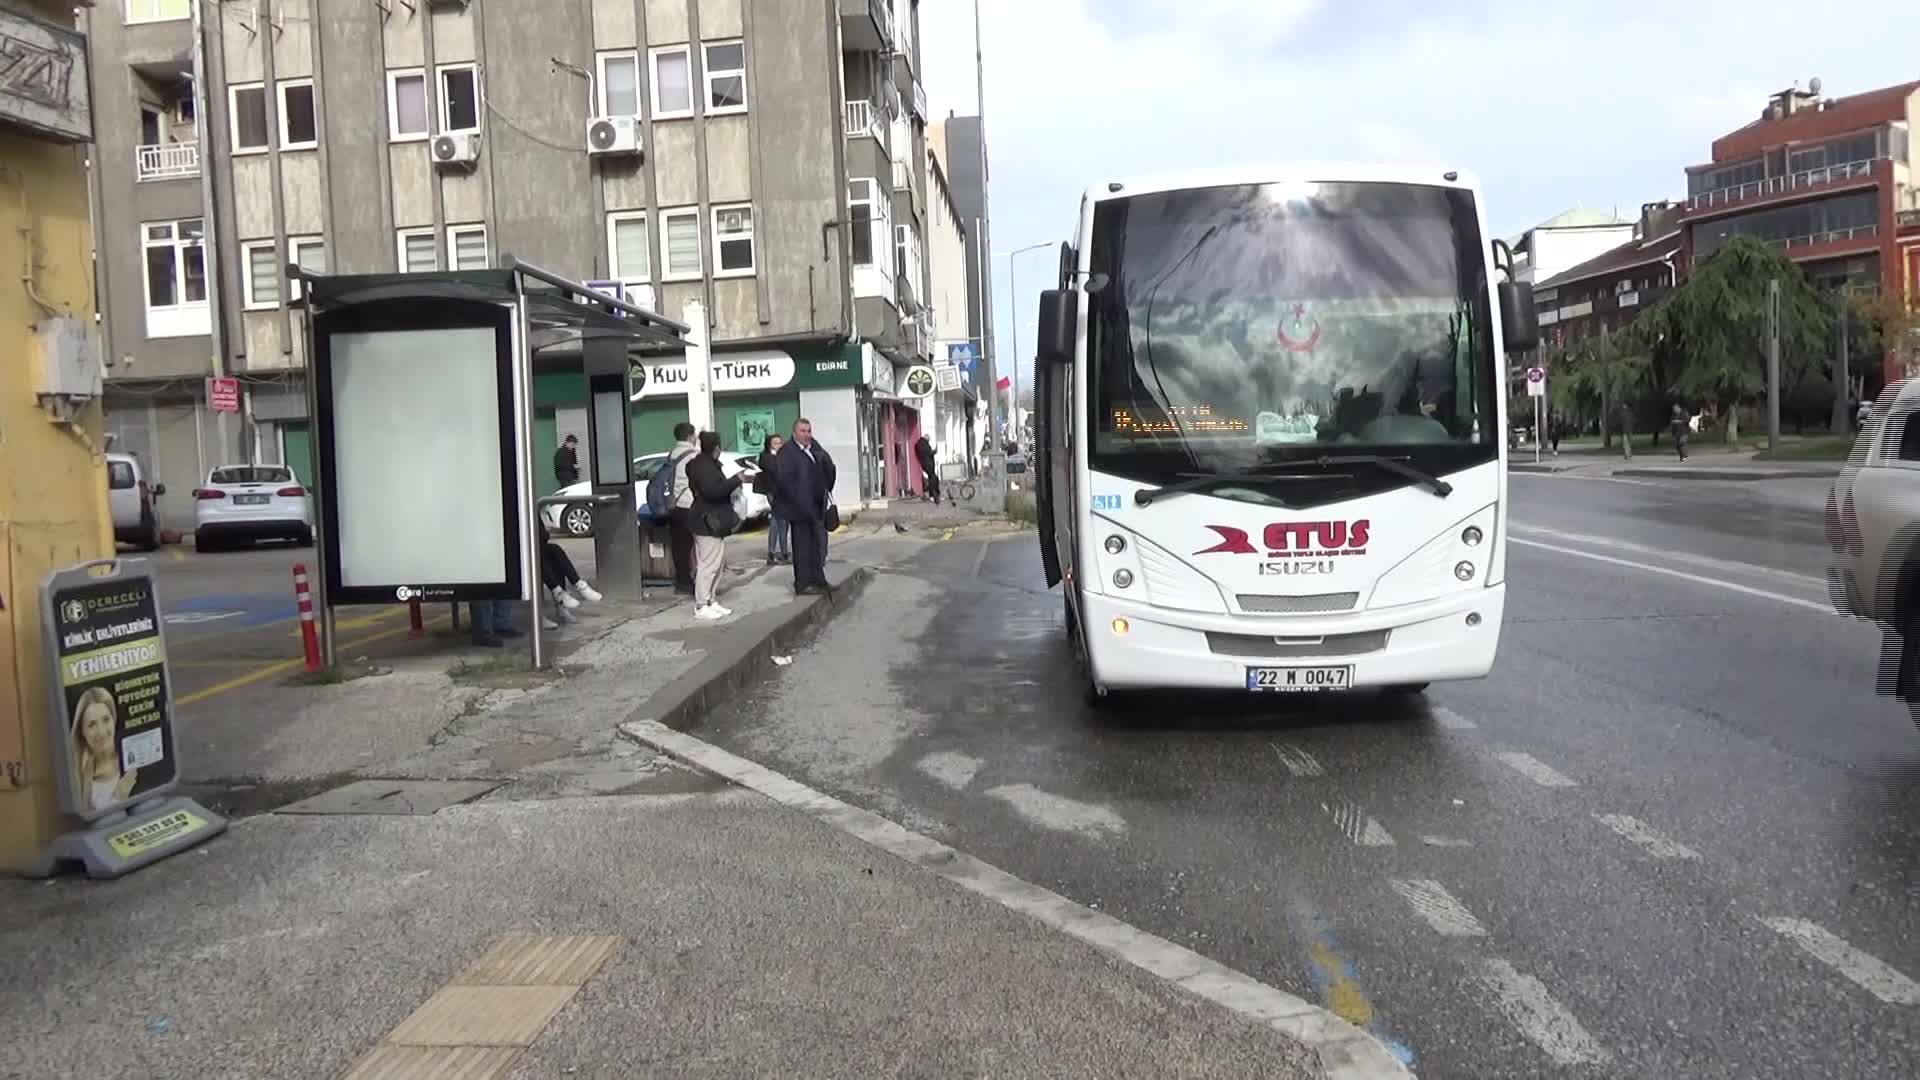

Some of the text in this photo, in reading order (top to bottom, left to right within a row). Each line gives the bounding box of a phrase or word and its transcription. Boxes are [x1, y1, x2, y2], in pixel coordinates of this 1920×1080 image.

[653, 361, 771, 384] KUVTTÜRK
[816, 360, 849, 372] EDİRNE
[1263, 519, 1370, 550] ETUS
[1258, 560, 1334, 576] ISUZU
[1258, 670, 1278, 685] 22
[1305, 669, 1346, 685] 0047
